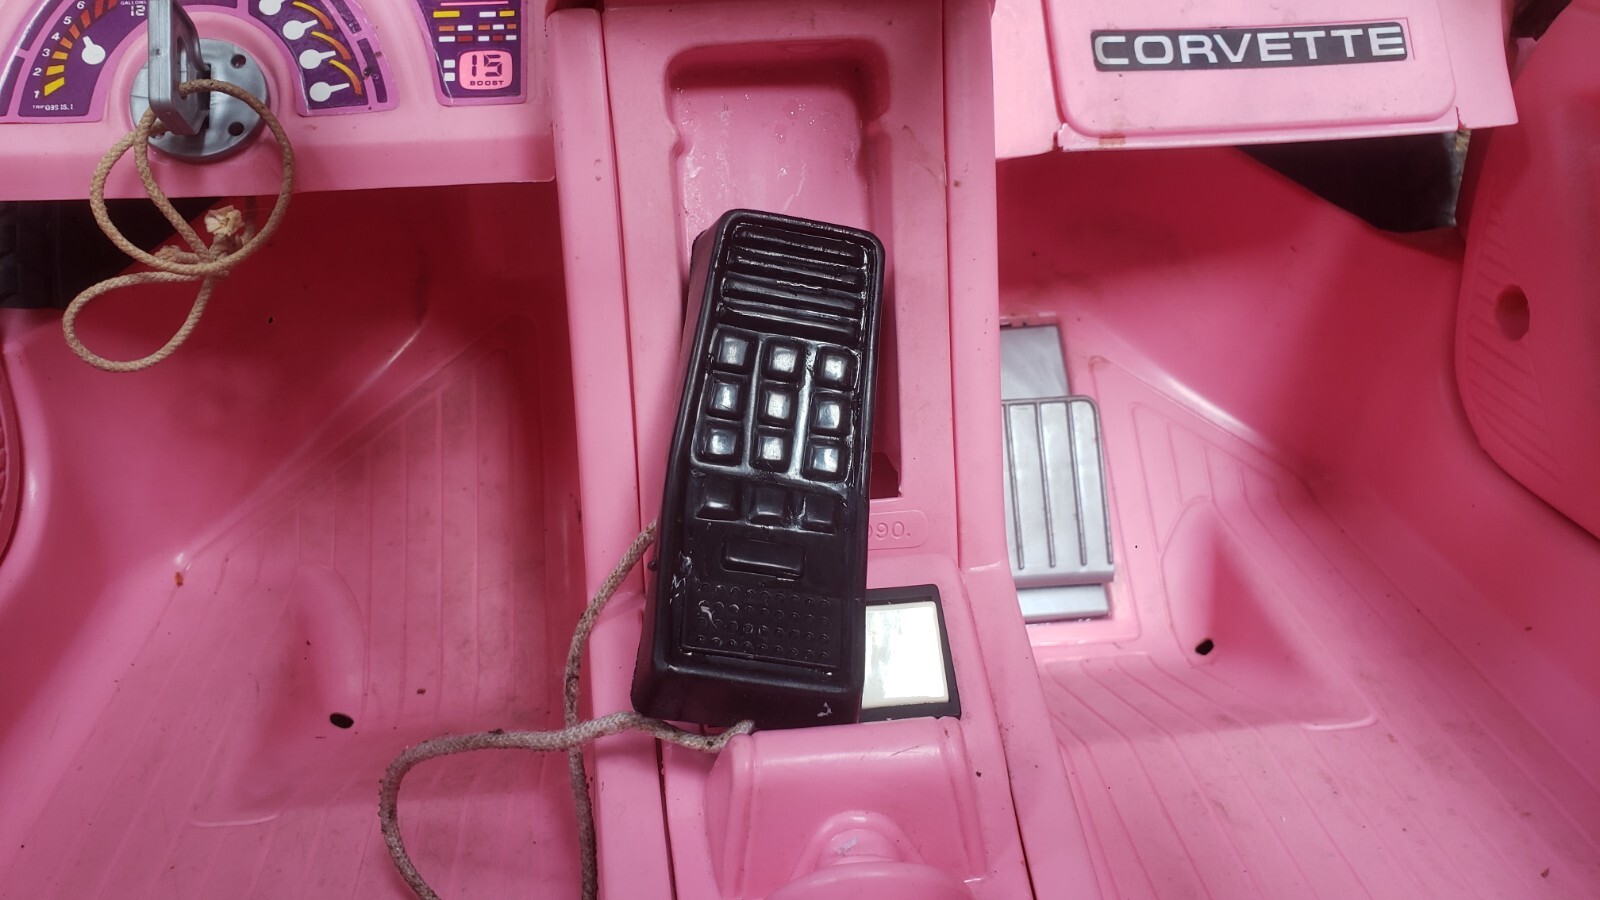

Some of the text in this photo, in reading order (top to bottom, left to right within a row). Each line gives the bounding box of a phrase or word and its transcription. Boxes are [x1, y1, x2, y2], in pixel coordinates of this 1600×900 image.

[76, 0, 86, 9] 6
[130, 4, 146, 17] 12
[63, 16, 72, 25] 5
[51, 32, 60, 41] 4
[1095, 26, 1405, 65] CORVETTE
[42, 48, 51, 57] 3
[471, 54, 503, 77] 15
[32, 67, 42, 76] 2
[33, 90, 40, 99] 1
[869, 521, 911, 538] 90.
